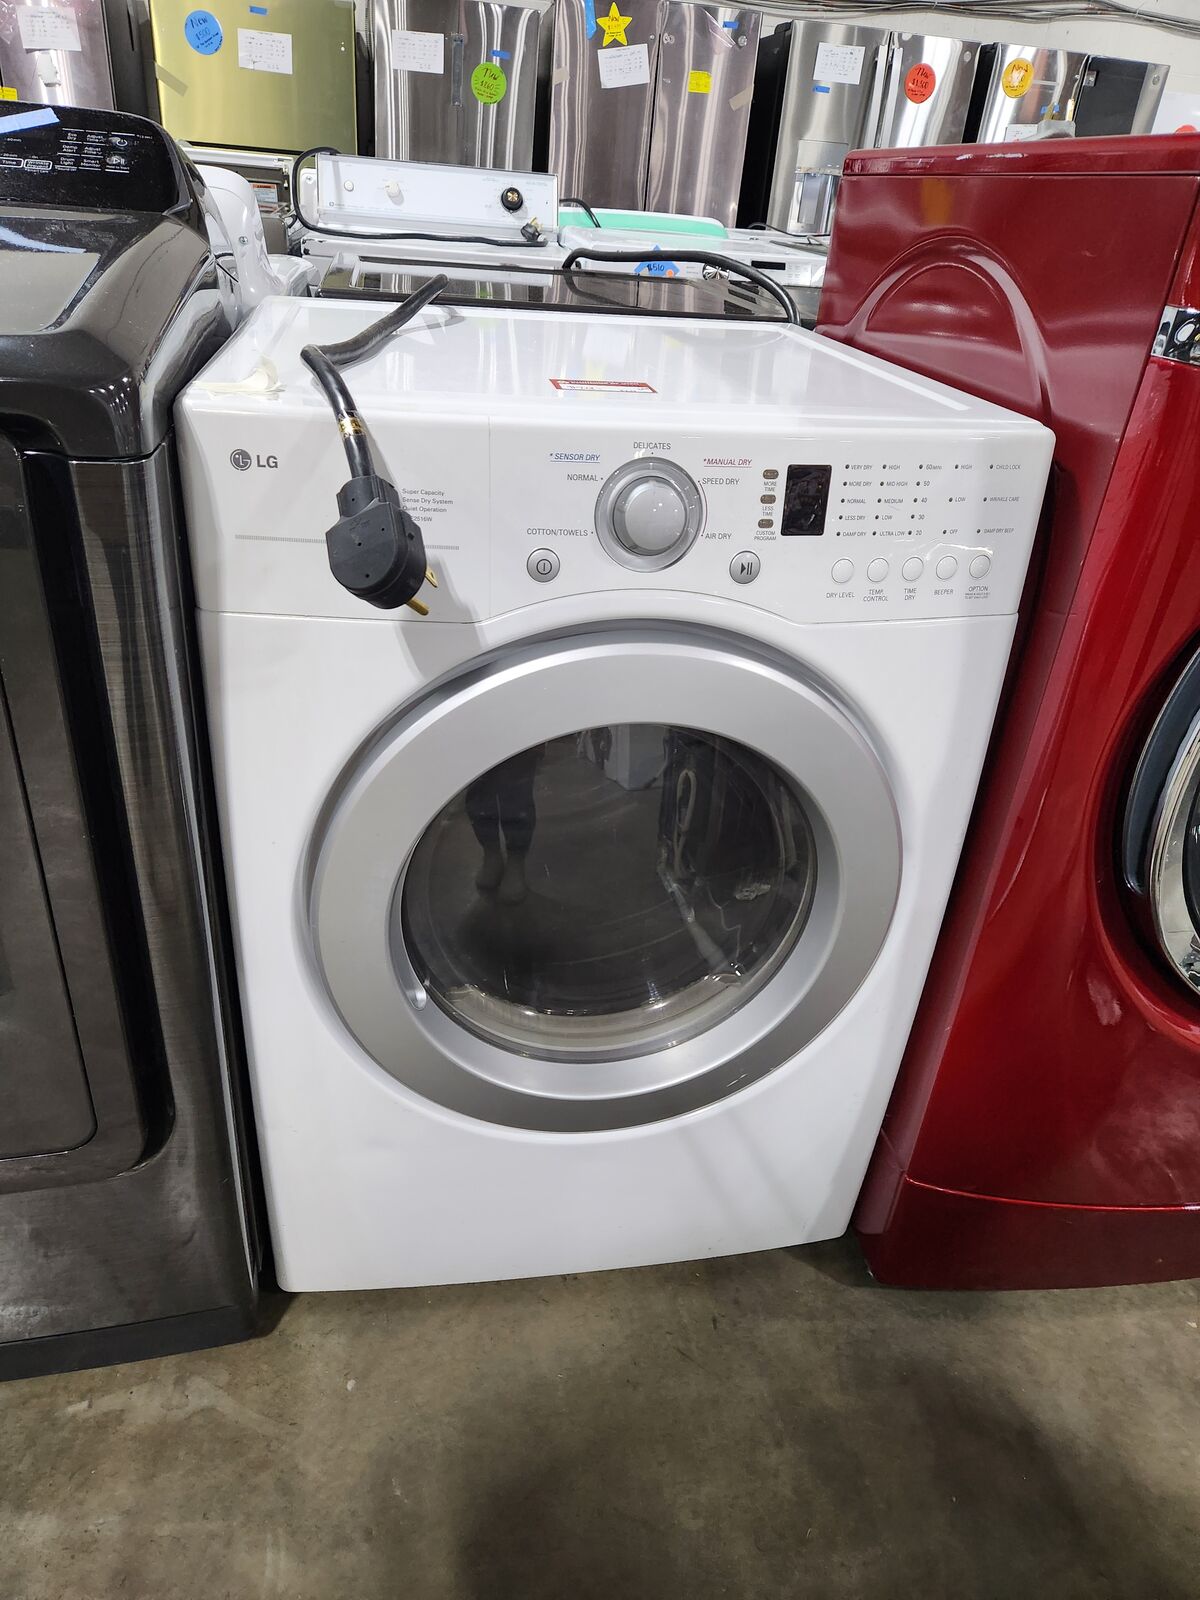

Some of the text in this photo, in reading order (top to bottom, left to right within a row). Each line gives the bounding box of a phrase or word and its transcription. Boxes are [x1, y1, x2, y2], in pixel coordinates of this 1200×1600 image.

[190, 16, 208, 28] New
[633, 441, 671, 450] DELICATES
[554, 452, 584, 461] SENSOR
[585, 453, 600, 461] DRY
[256, 454, 278, 469] LG
[738, 458, 752, 466] DRY
[566, 473, 598, 481] NORMAL
[702, 477, 724, 485] SPEED
[402, 488, 445, 497] Super Capacity
[420, 497, 432, 505] Dry
[526, 528, 589, 537] COTTON/TOWELS
[838, 591, 855, 599] LEVEL
[933, 588, 954, 596] BEEPER
